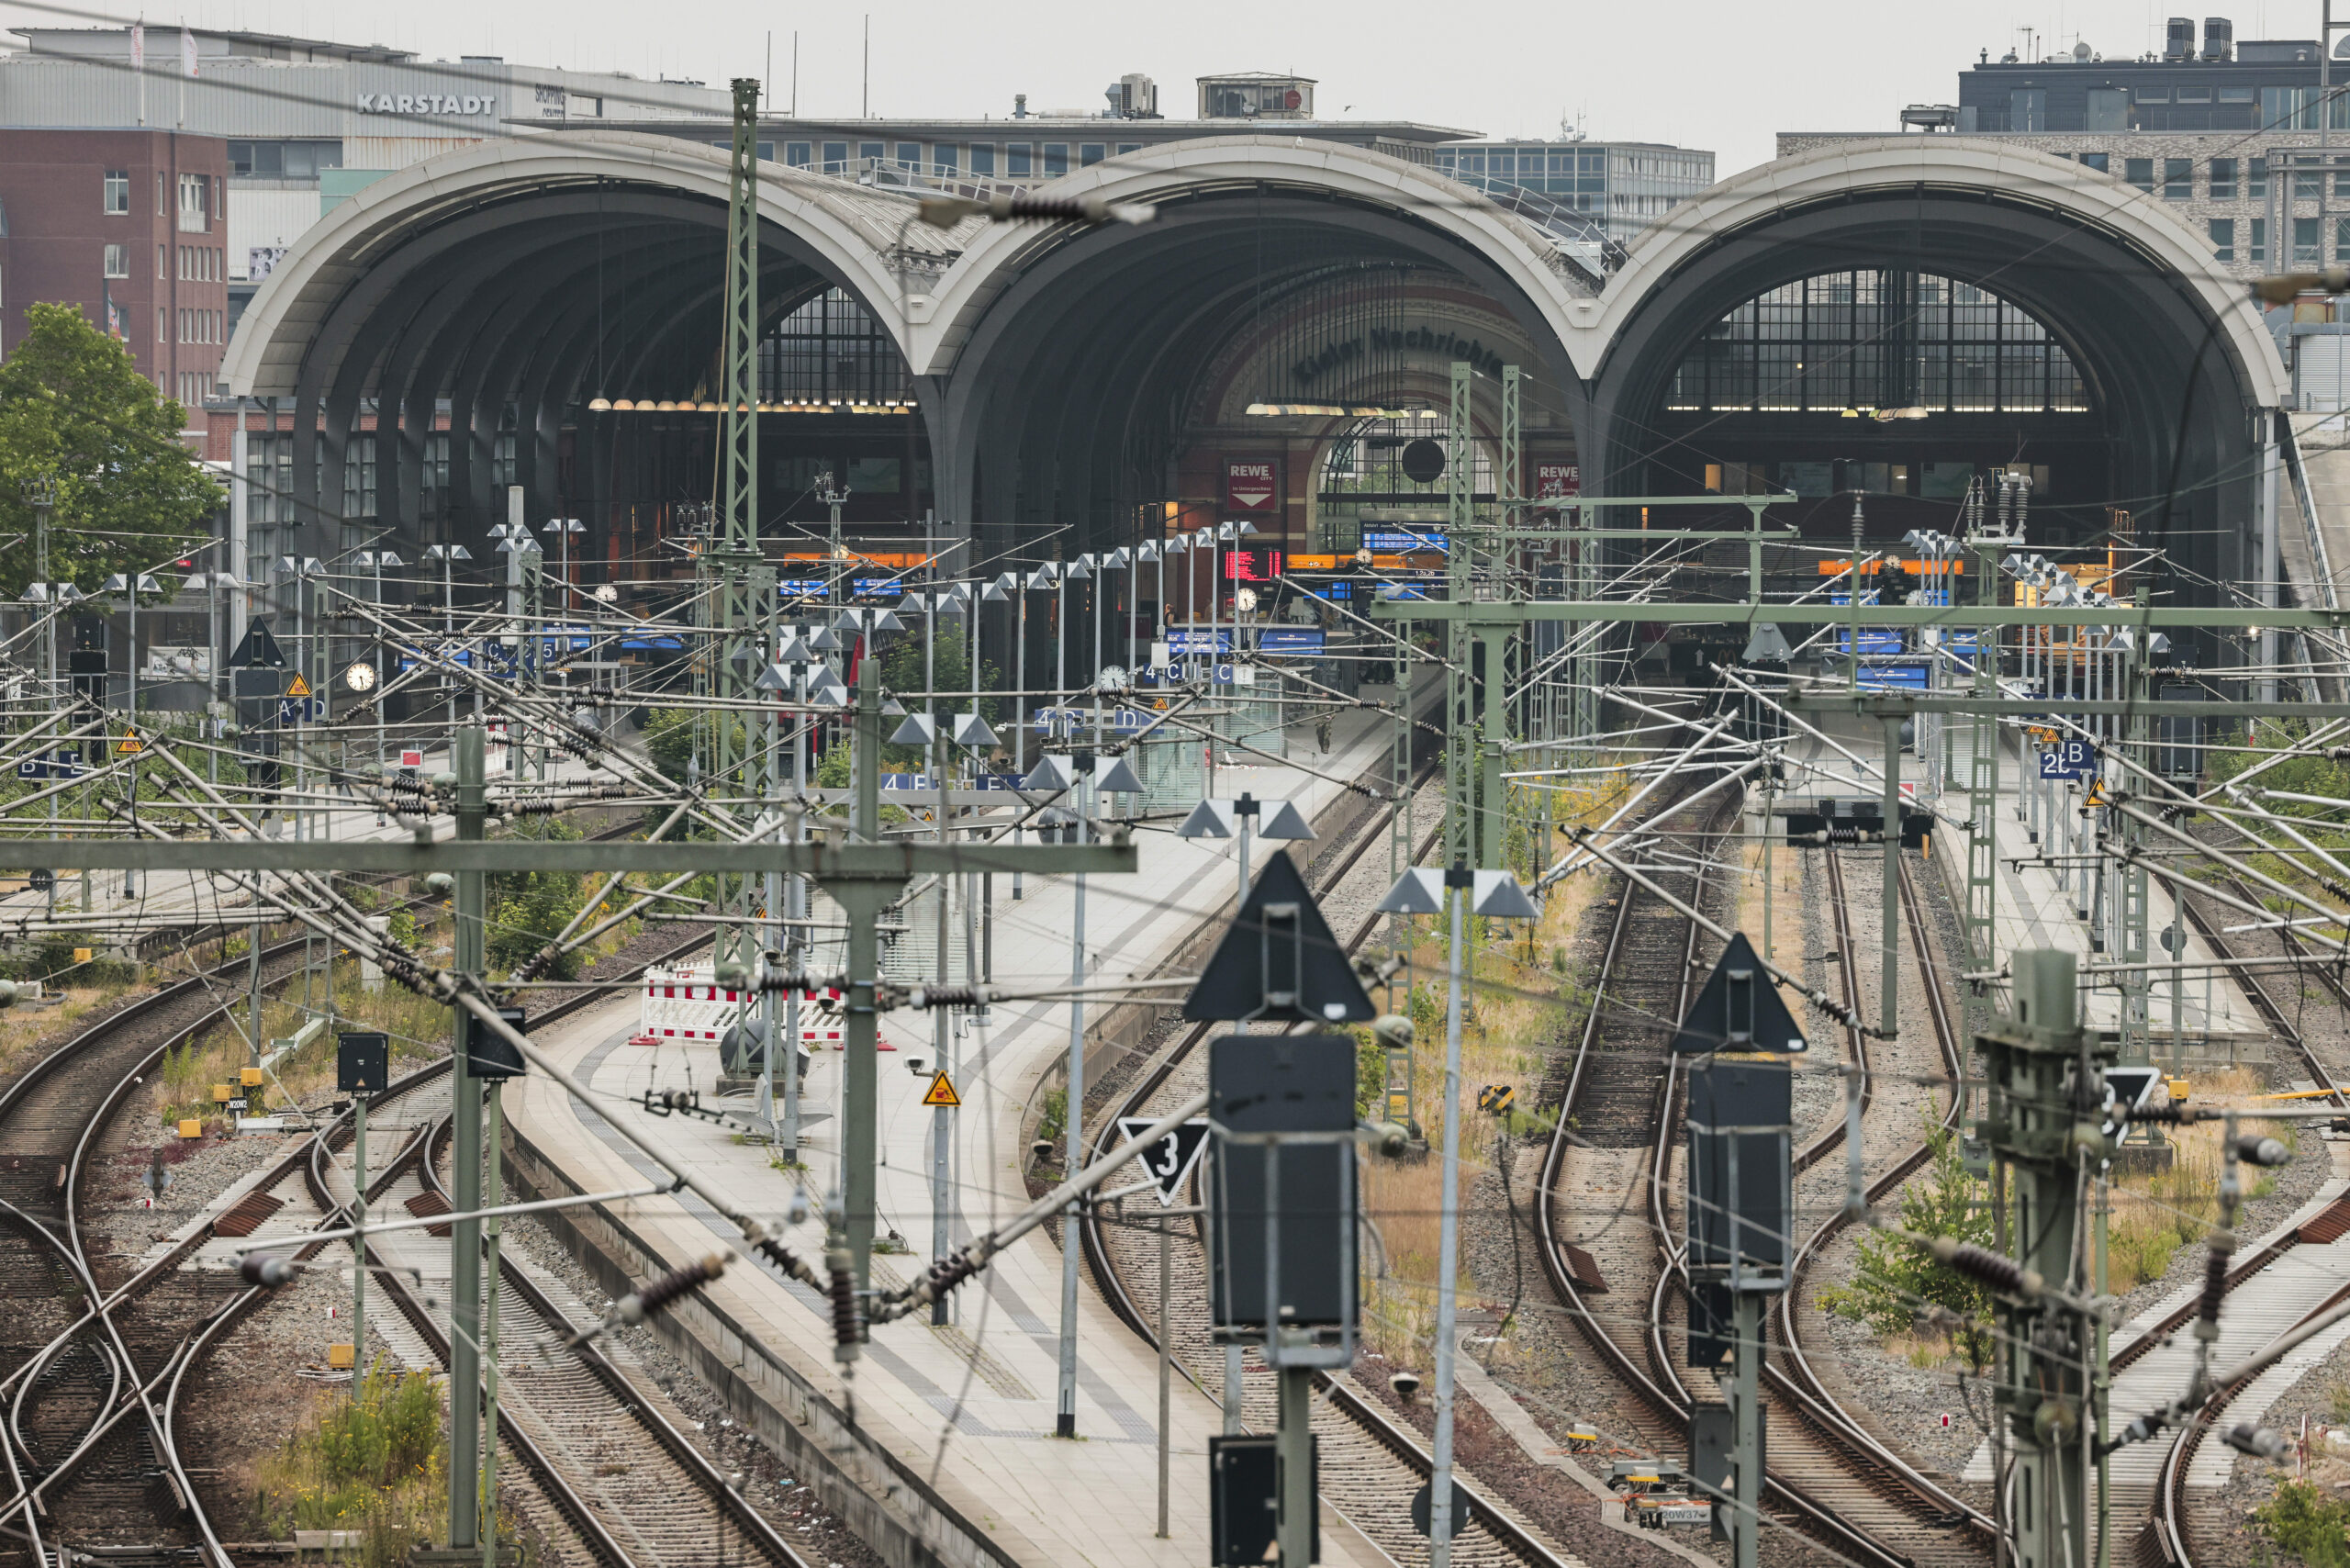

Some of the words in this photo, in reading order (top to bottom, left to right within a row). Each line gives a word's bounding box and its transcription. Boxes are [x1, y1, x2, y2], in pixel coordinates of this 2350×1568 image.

[535, 83, 565, 105] SHOPPING
[357, 94, 496, 115] KARSTADT
[1370, 325, 1504, 375] Nachrichte
[1230, 465, 1270, 476] REWE
[1539, 466, 1579, 477] REWE
[543, 644, 553, 658] 5
[1146, 663, 1156, 679] 4
[1167, 663, 1180, 679] C
[1218, 665, 1231, 680] C
[280, 700, 291, 717] A
[1123, 711, 1136, 727] D
[2068, 743, 2084, 763] B
[884, 774, 900, 790] 4
[1156, 1130, 1179, 1177] 3
[1662, 1509, 1699, 1519] 20W37
